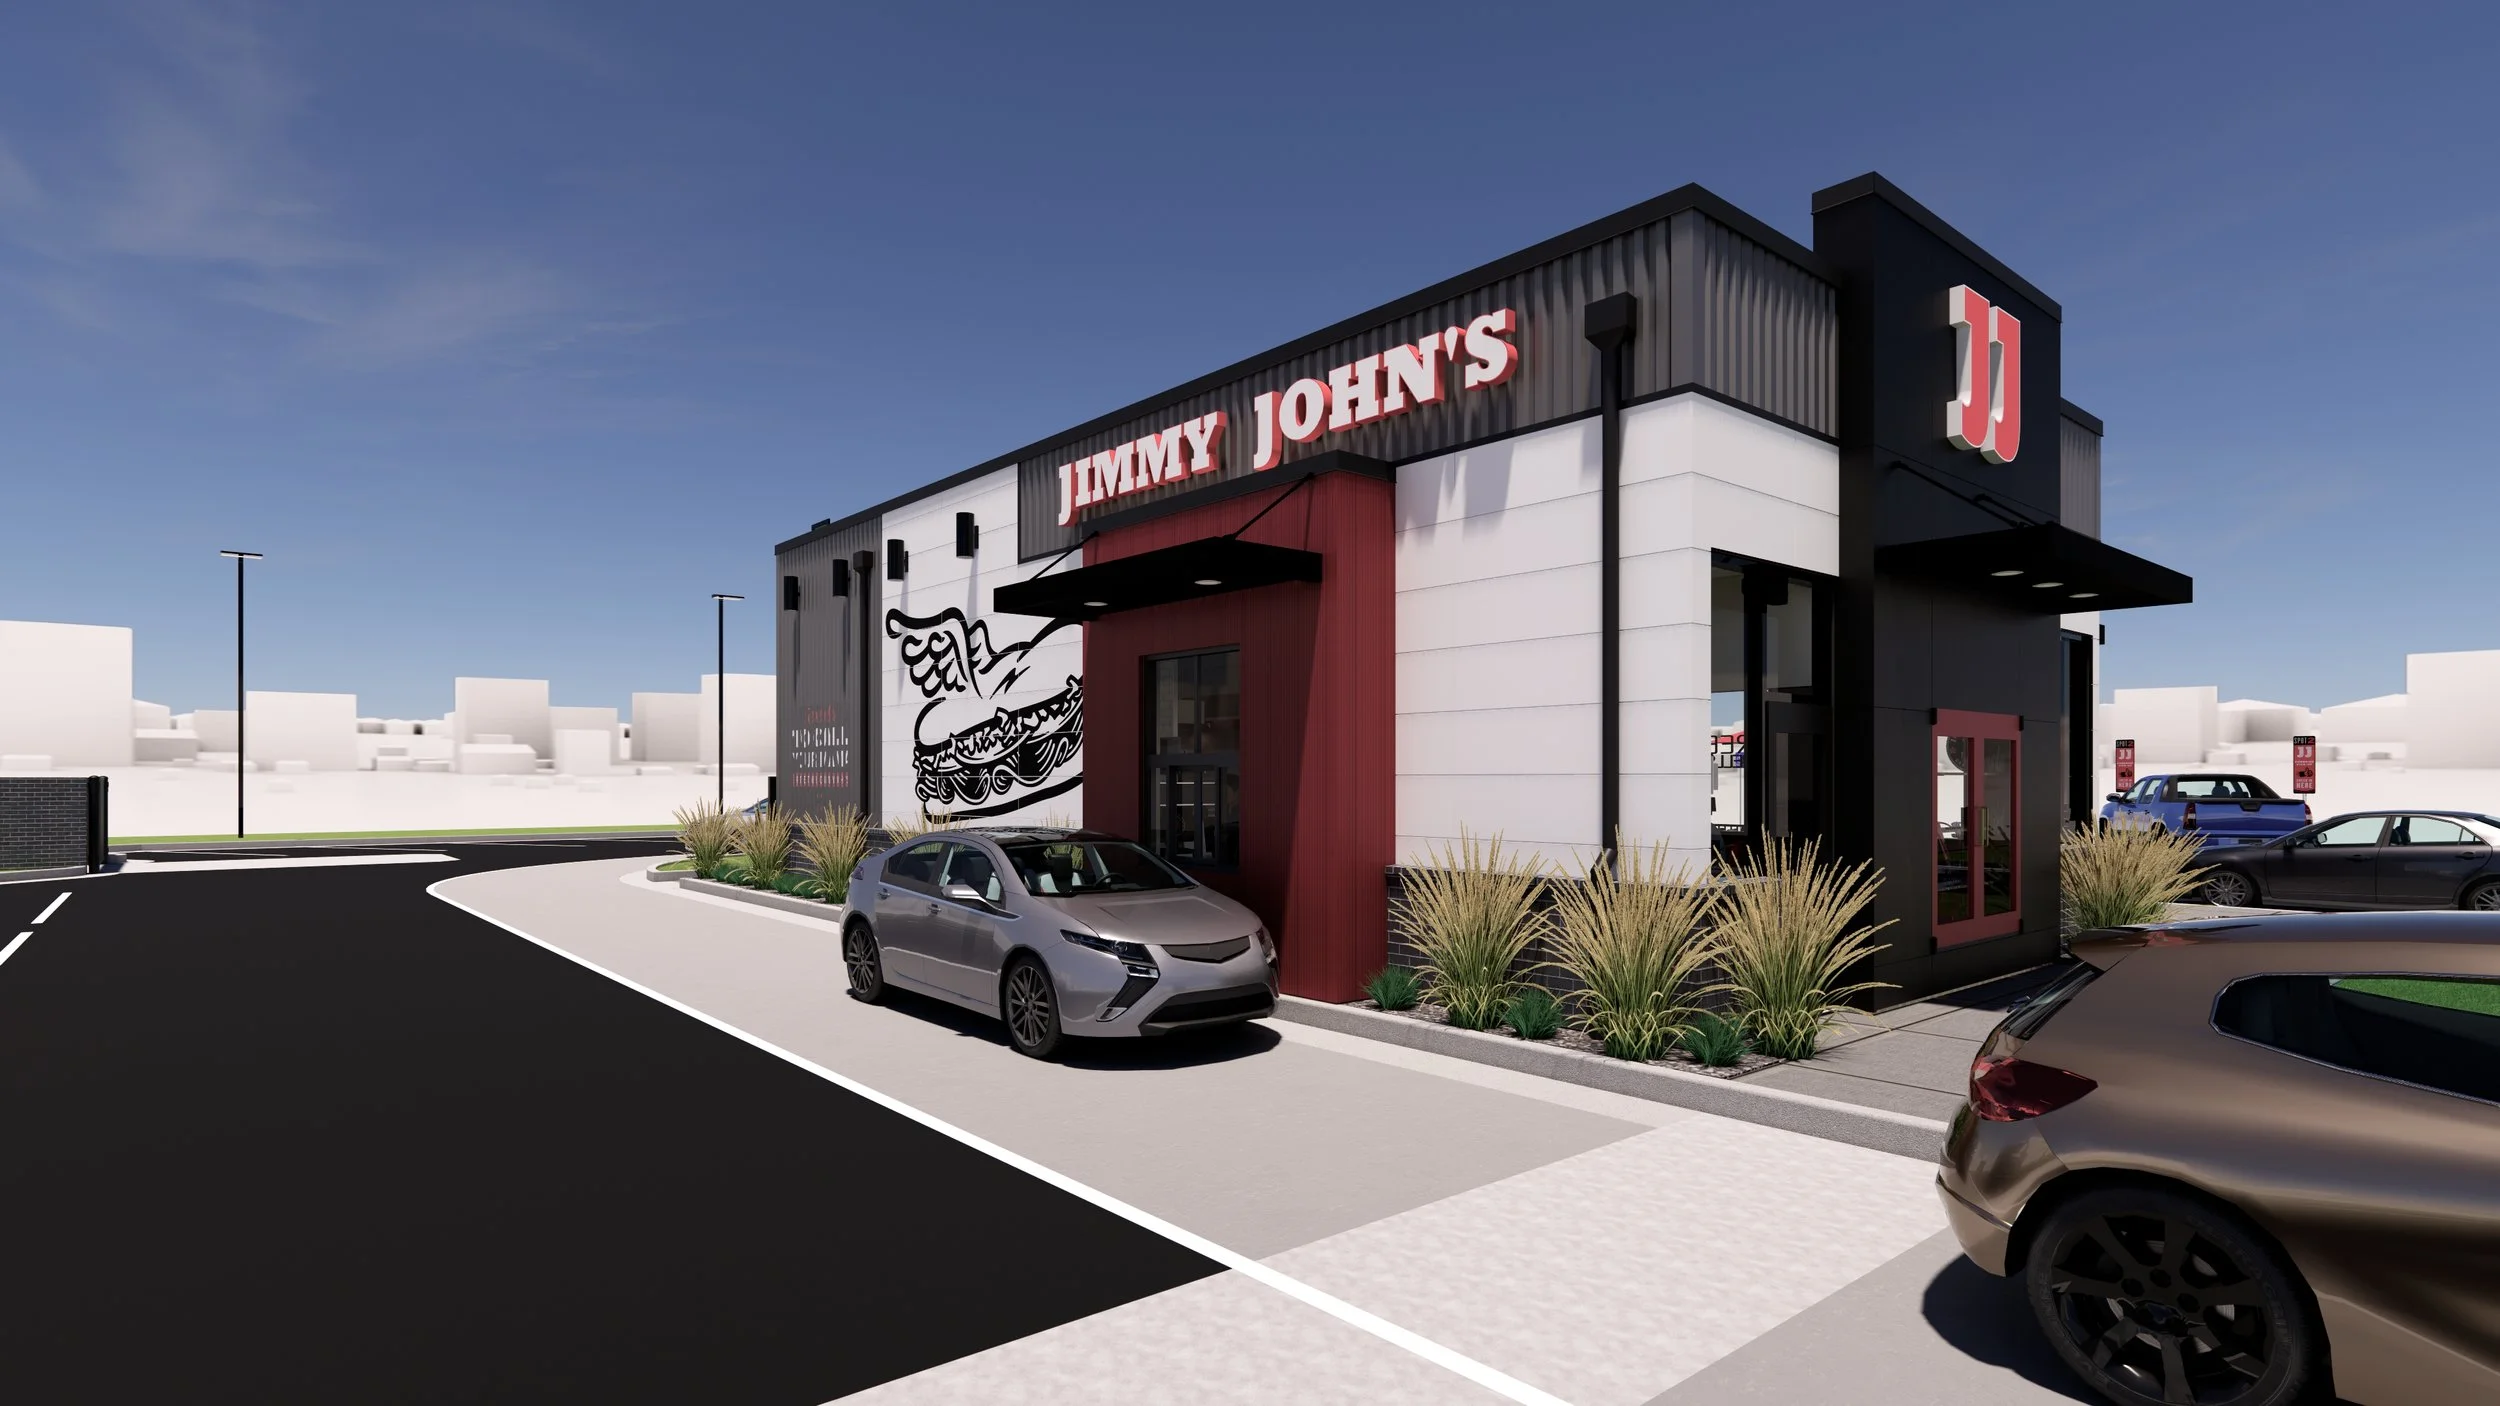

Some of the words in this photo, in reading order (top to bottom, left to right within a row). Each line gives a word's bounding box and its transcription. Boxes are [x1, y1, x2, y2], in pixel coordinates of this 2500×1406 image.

[1058, 410, 1227, 527] JIMMY
[1253, 308, 1518, 471] JOHN'S
[1947, 284, 2020, 464] JJ
[2296, 746, 2312, 758] JJ
